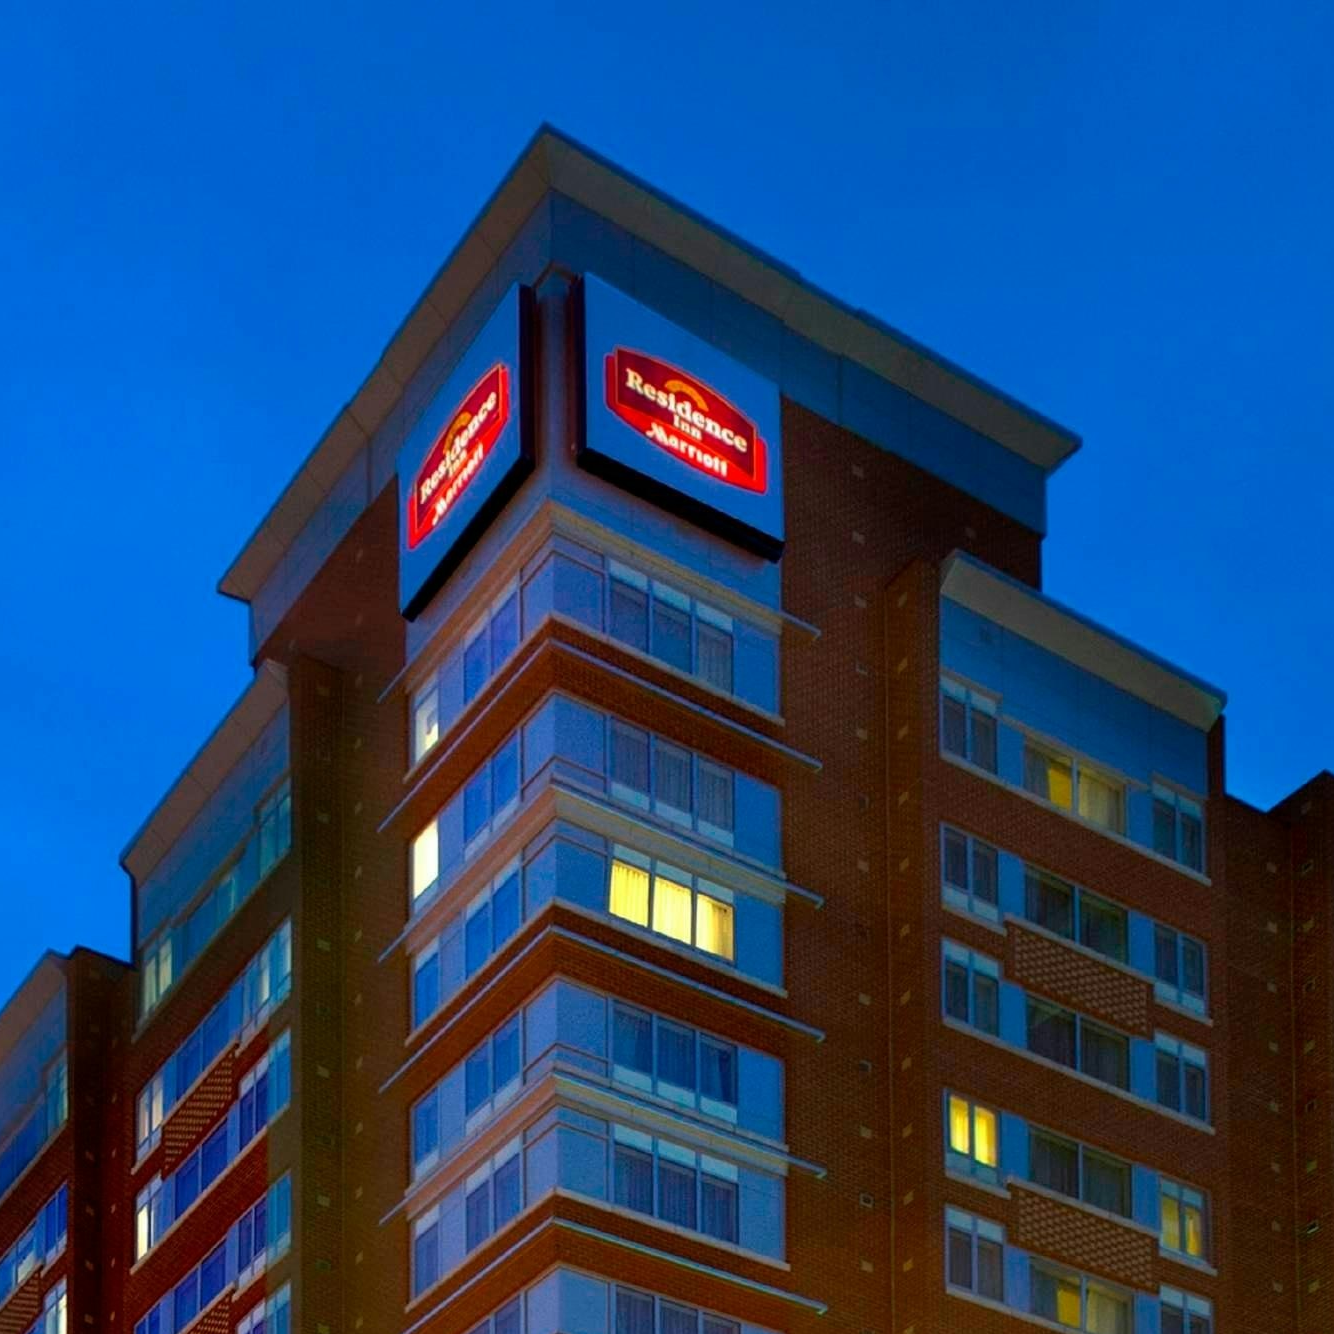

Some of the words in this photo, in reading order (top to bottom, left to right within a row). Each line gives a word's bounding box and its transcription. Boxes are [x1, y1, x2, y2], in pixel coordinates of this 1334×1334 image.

[625, 367, 748, 453] Residence
[673, 414, 703, 440] Inn
[420, 391, 497, 504] Residence
[645, 422, 729, 477] Marriott
